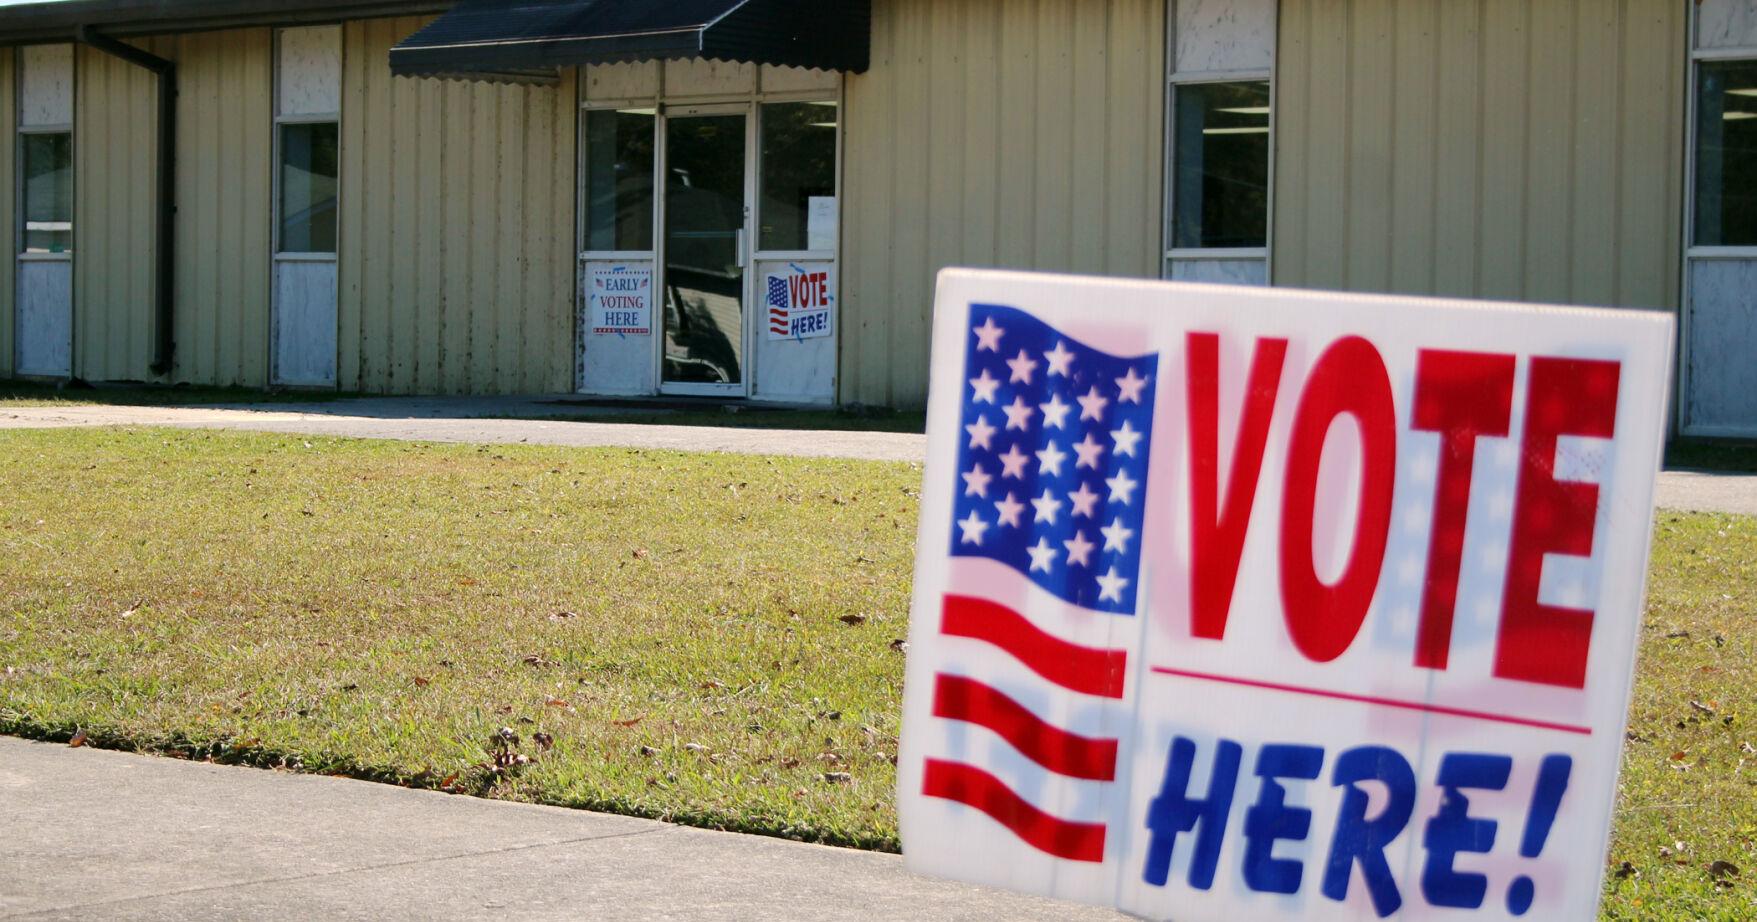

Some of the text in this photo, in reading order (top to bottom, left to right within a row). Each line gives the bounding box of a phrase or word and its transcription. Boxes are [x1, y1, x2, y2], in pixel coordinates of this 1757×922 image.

[606, 278, 640, 291] EARLY
[788, 271, 828, 309] VOTE
[600, 296, 644, 309] VOTING
[605, 311, 639, 326] HERE
[791, 311, 828, 336] HERE!
[1184, 331, 1622, 690] VOTE
[1141, 734, 1574, 920] HERE!
